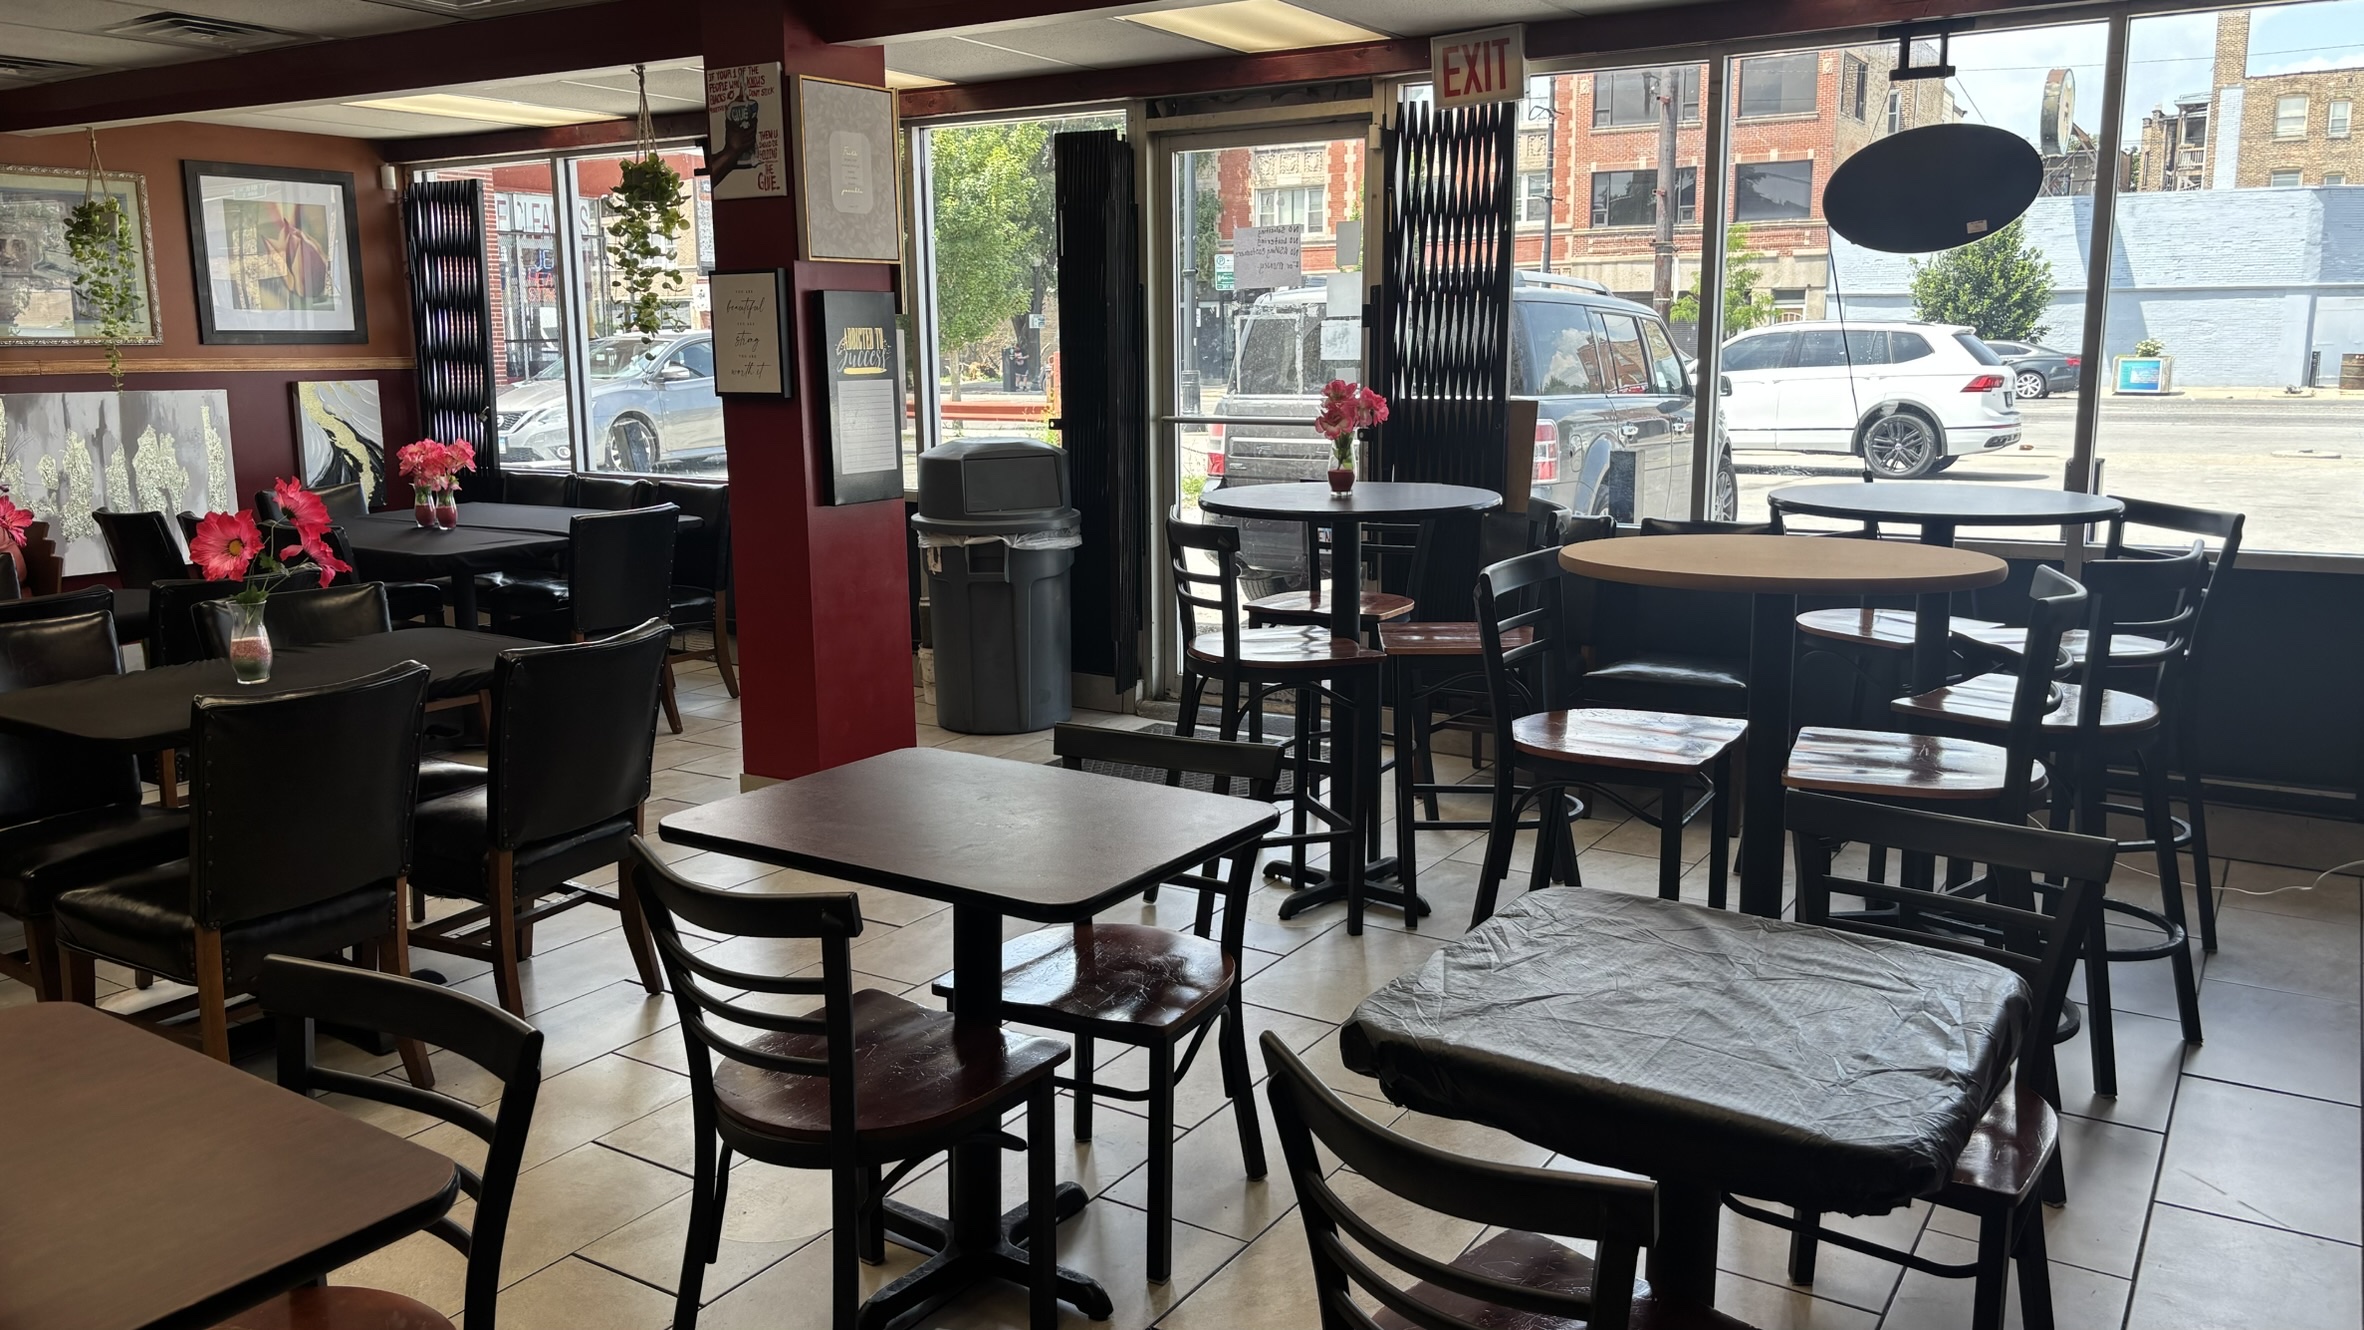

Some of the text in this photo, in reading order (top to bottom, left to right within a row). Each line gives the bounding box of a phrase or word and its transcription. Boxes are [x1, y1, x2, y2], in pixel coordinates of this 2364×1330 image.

[748, 66, 759, 75] THE
[1442, 37, 1510, 98] EXIT
[709, 82, 729, 94] PEOPLE
[726, 297, 765, 319] beautiful
[734, 330, 760, 352] strong
